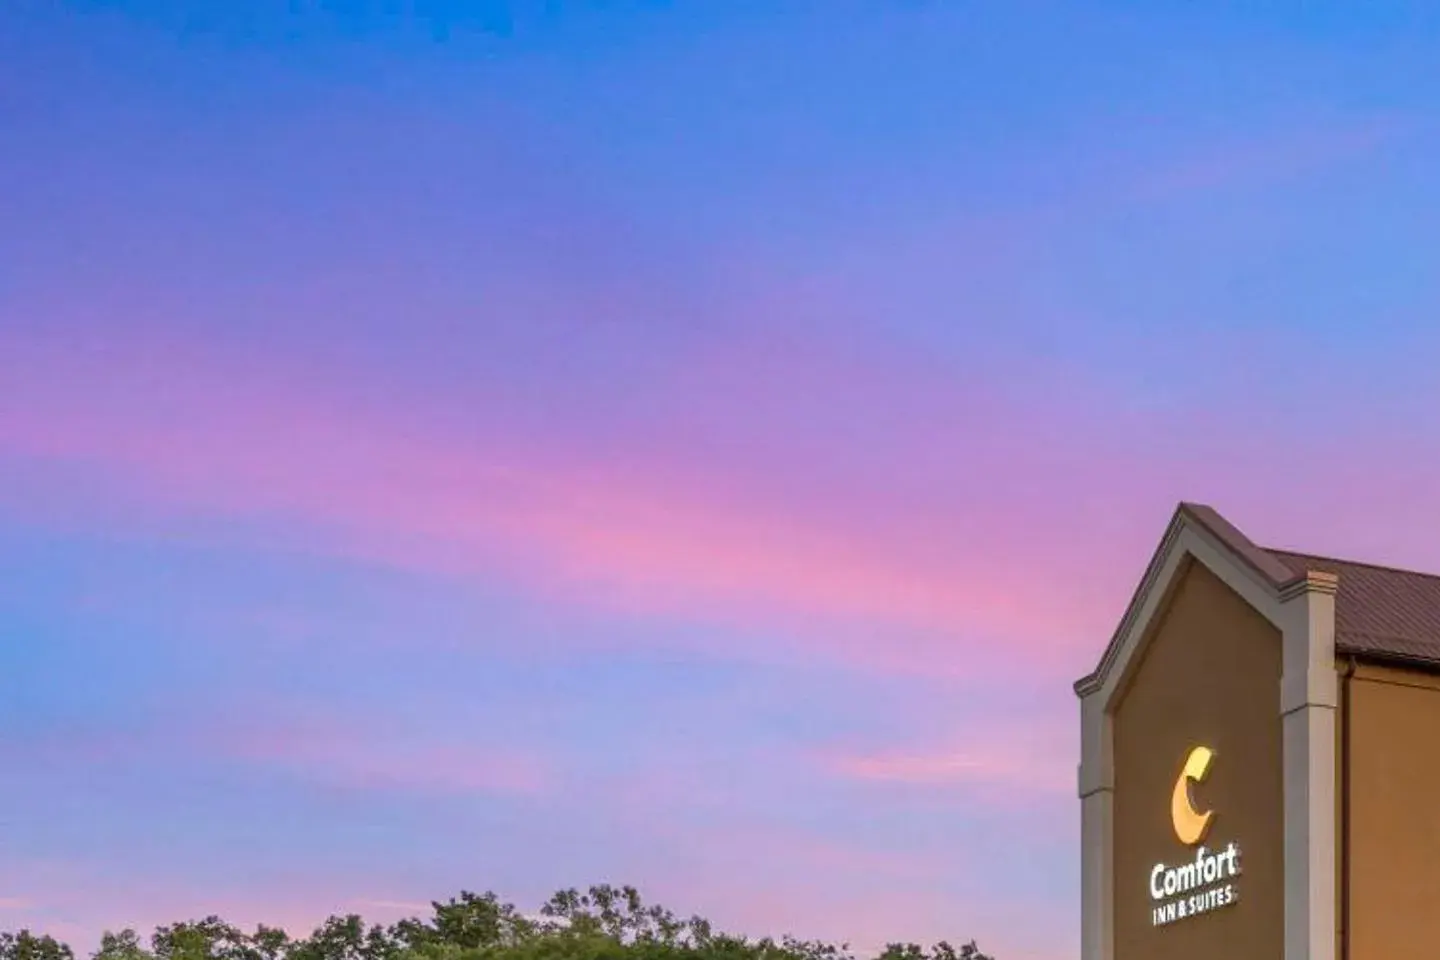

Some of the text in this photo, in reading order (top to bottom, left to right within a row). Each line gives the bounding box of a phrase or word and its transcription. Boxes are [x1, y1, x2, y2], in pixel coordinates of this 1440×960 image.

[1150, 843, 1237, 899] Comfort
[1153, 884, 1233, 926] INN & SUITES
